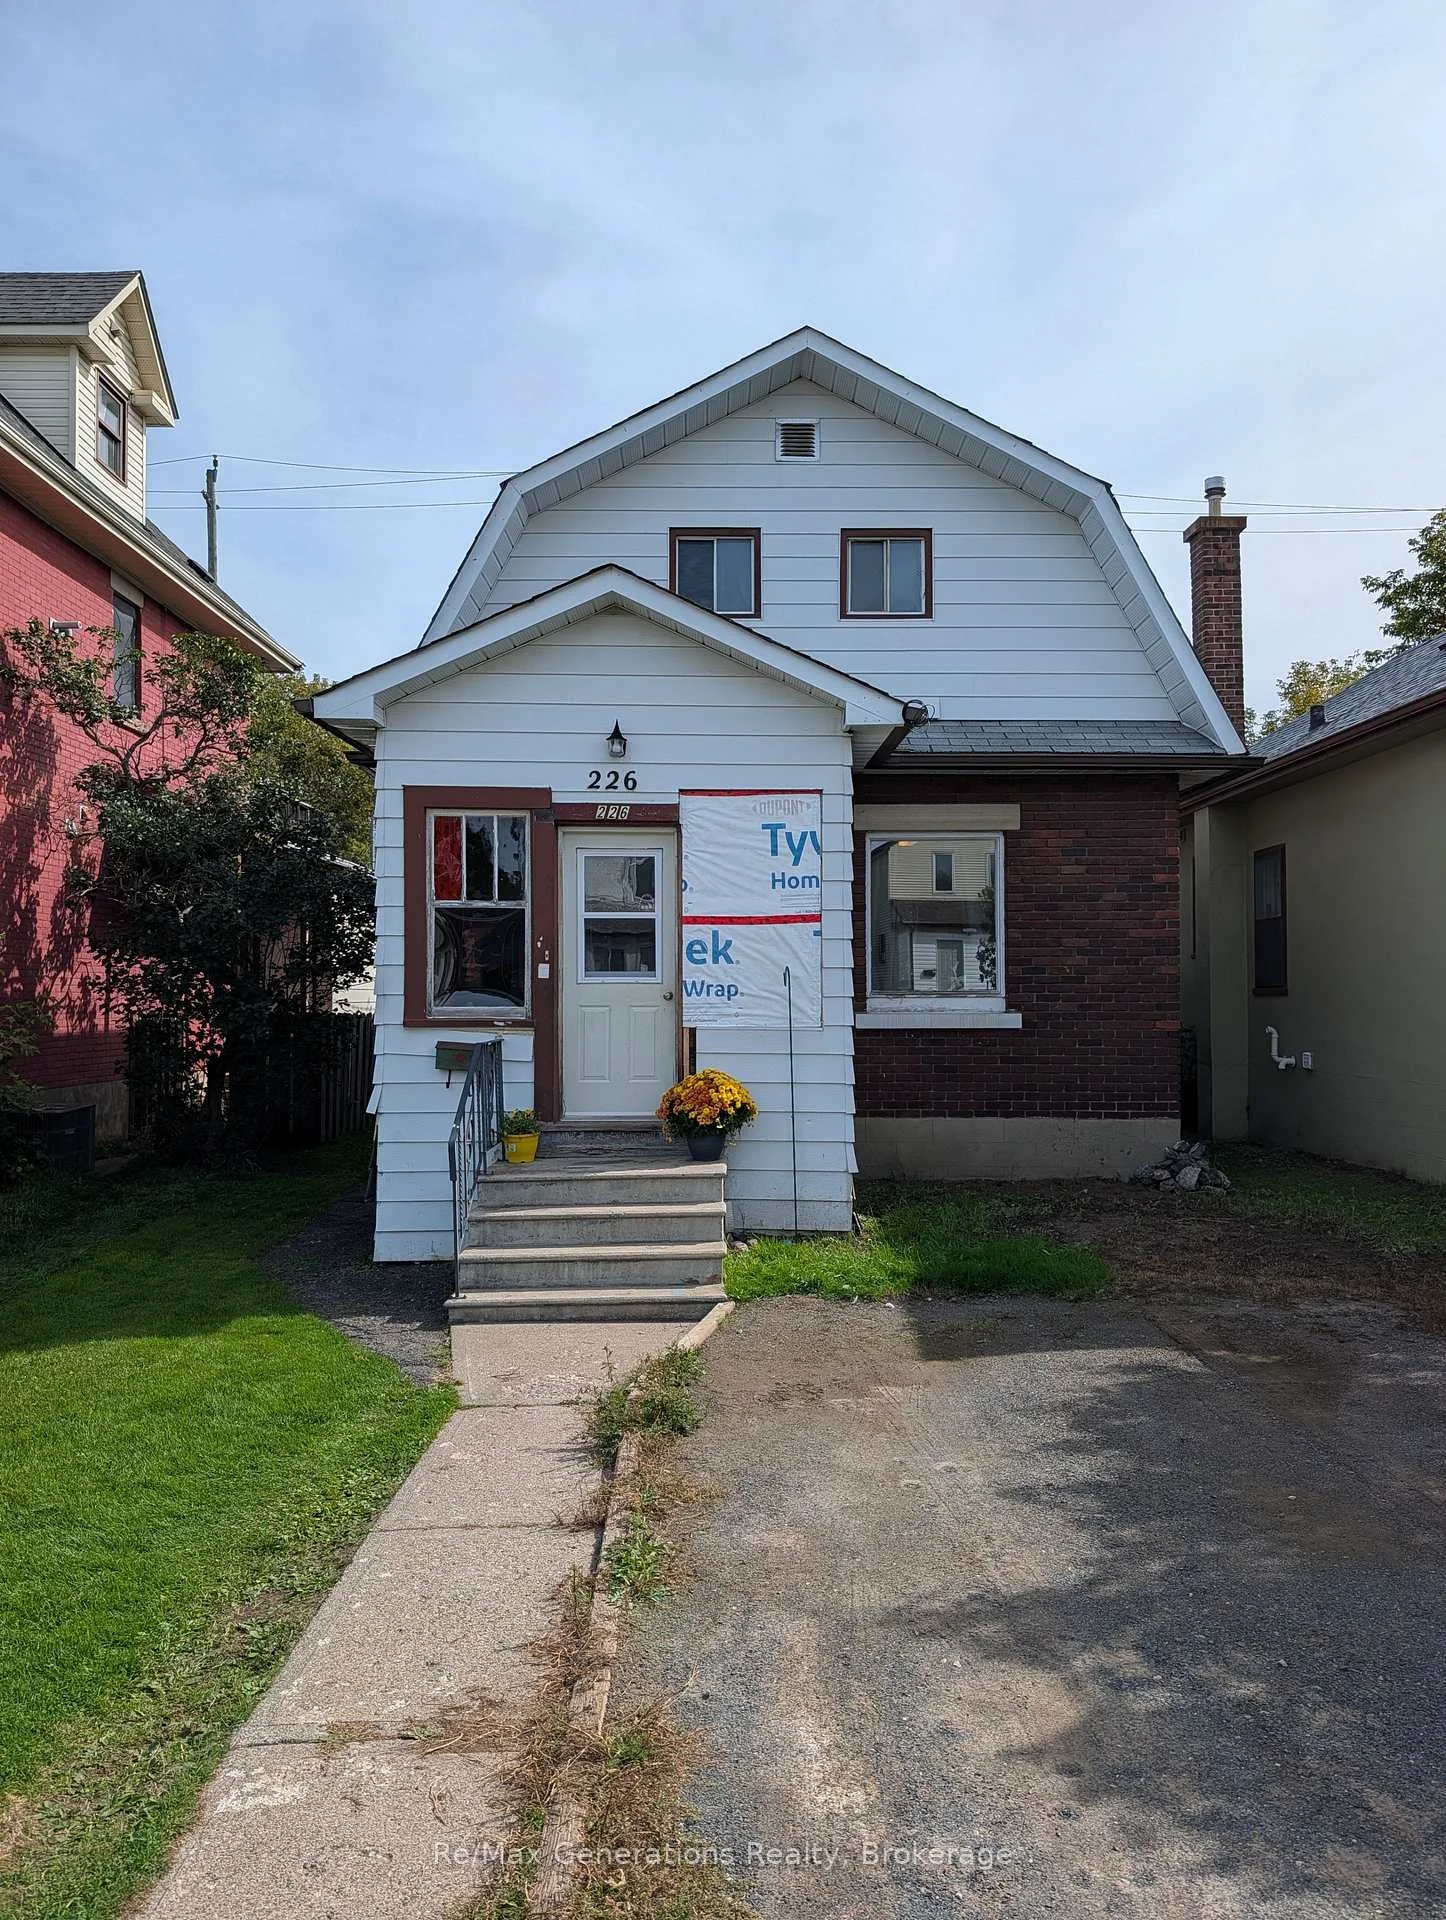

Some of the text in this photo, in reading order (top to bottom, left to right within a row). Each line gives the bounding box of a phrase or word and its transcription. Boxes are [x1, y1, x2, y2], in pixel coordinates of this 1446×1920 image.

[587, 770, 638, 791] 226
[596, 805, 630, 819] 226
[760, 800, 805, 816] DUPONT
[683, 980, 739, 1001] Wrap
